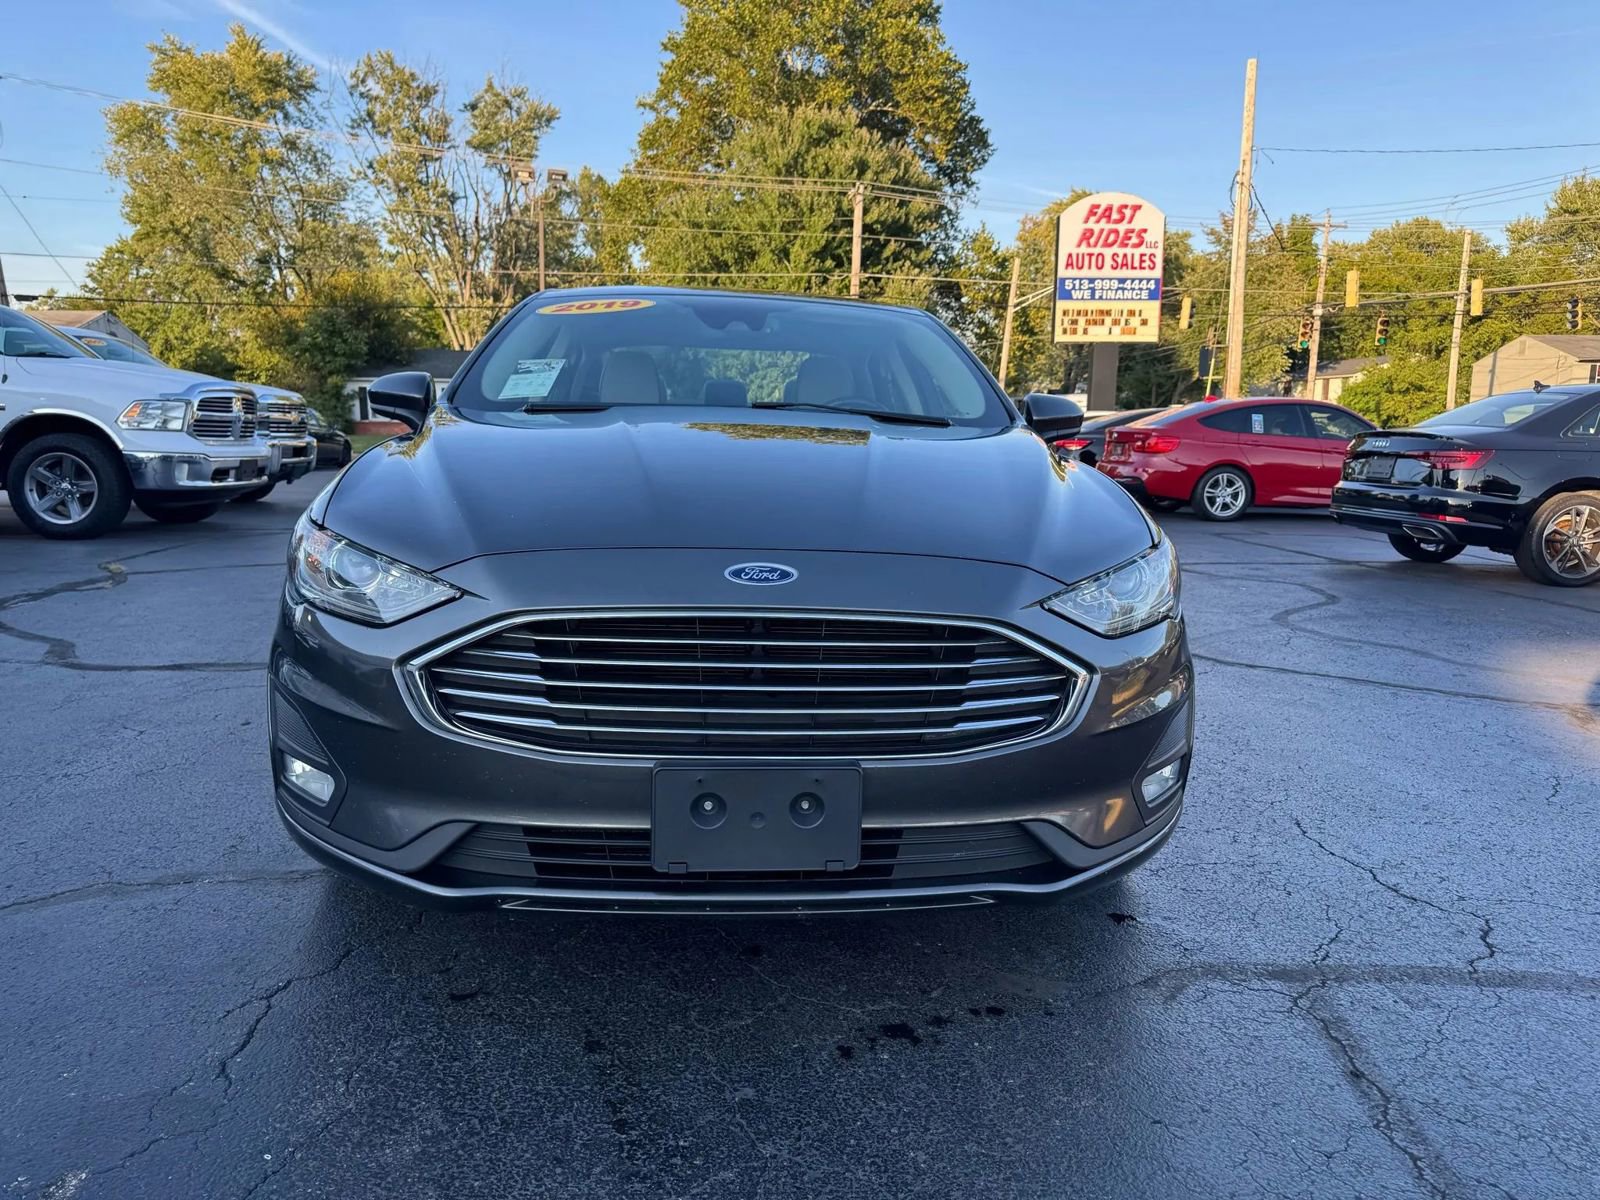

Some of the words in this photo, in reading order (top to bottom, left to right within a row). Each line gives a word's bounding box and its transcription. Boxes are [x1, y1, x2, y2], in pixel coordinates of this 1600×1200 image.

[1082, 203, 1143, 225] FAST
[1075, 228, 1148, 249] RIDES
[1145, 241, 1159, 249] LLC
[1065, 252, 1105, 271] AUTO
[1111, 252, 1157, 271] SALES
[1064, 279, 1156, 290] 513-999-4444
[1071, 290, 1092, 299] WE
[1095, 290, 1149, 299] FINANCE
[551, 300, 642, 313] 2019
[740, 566, 781, 580] Ford
